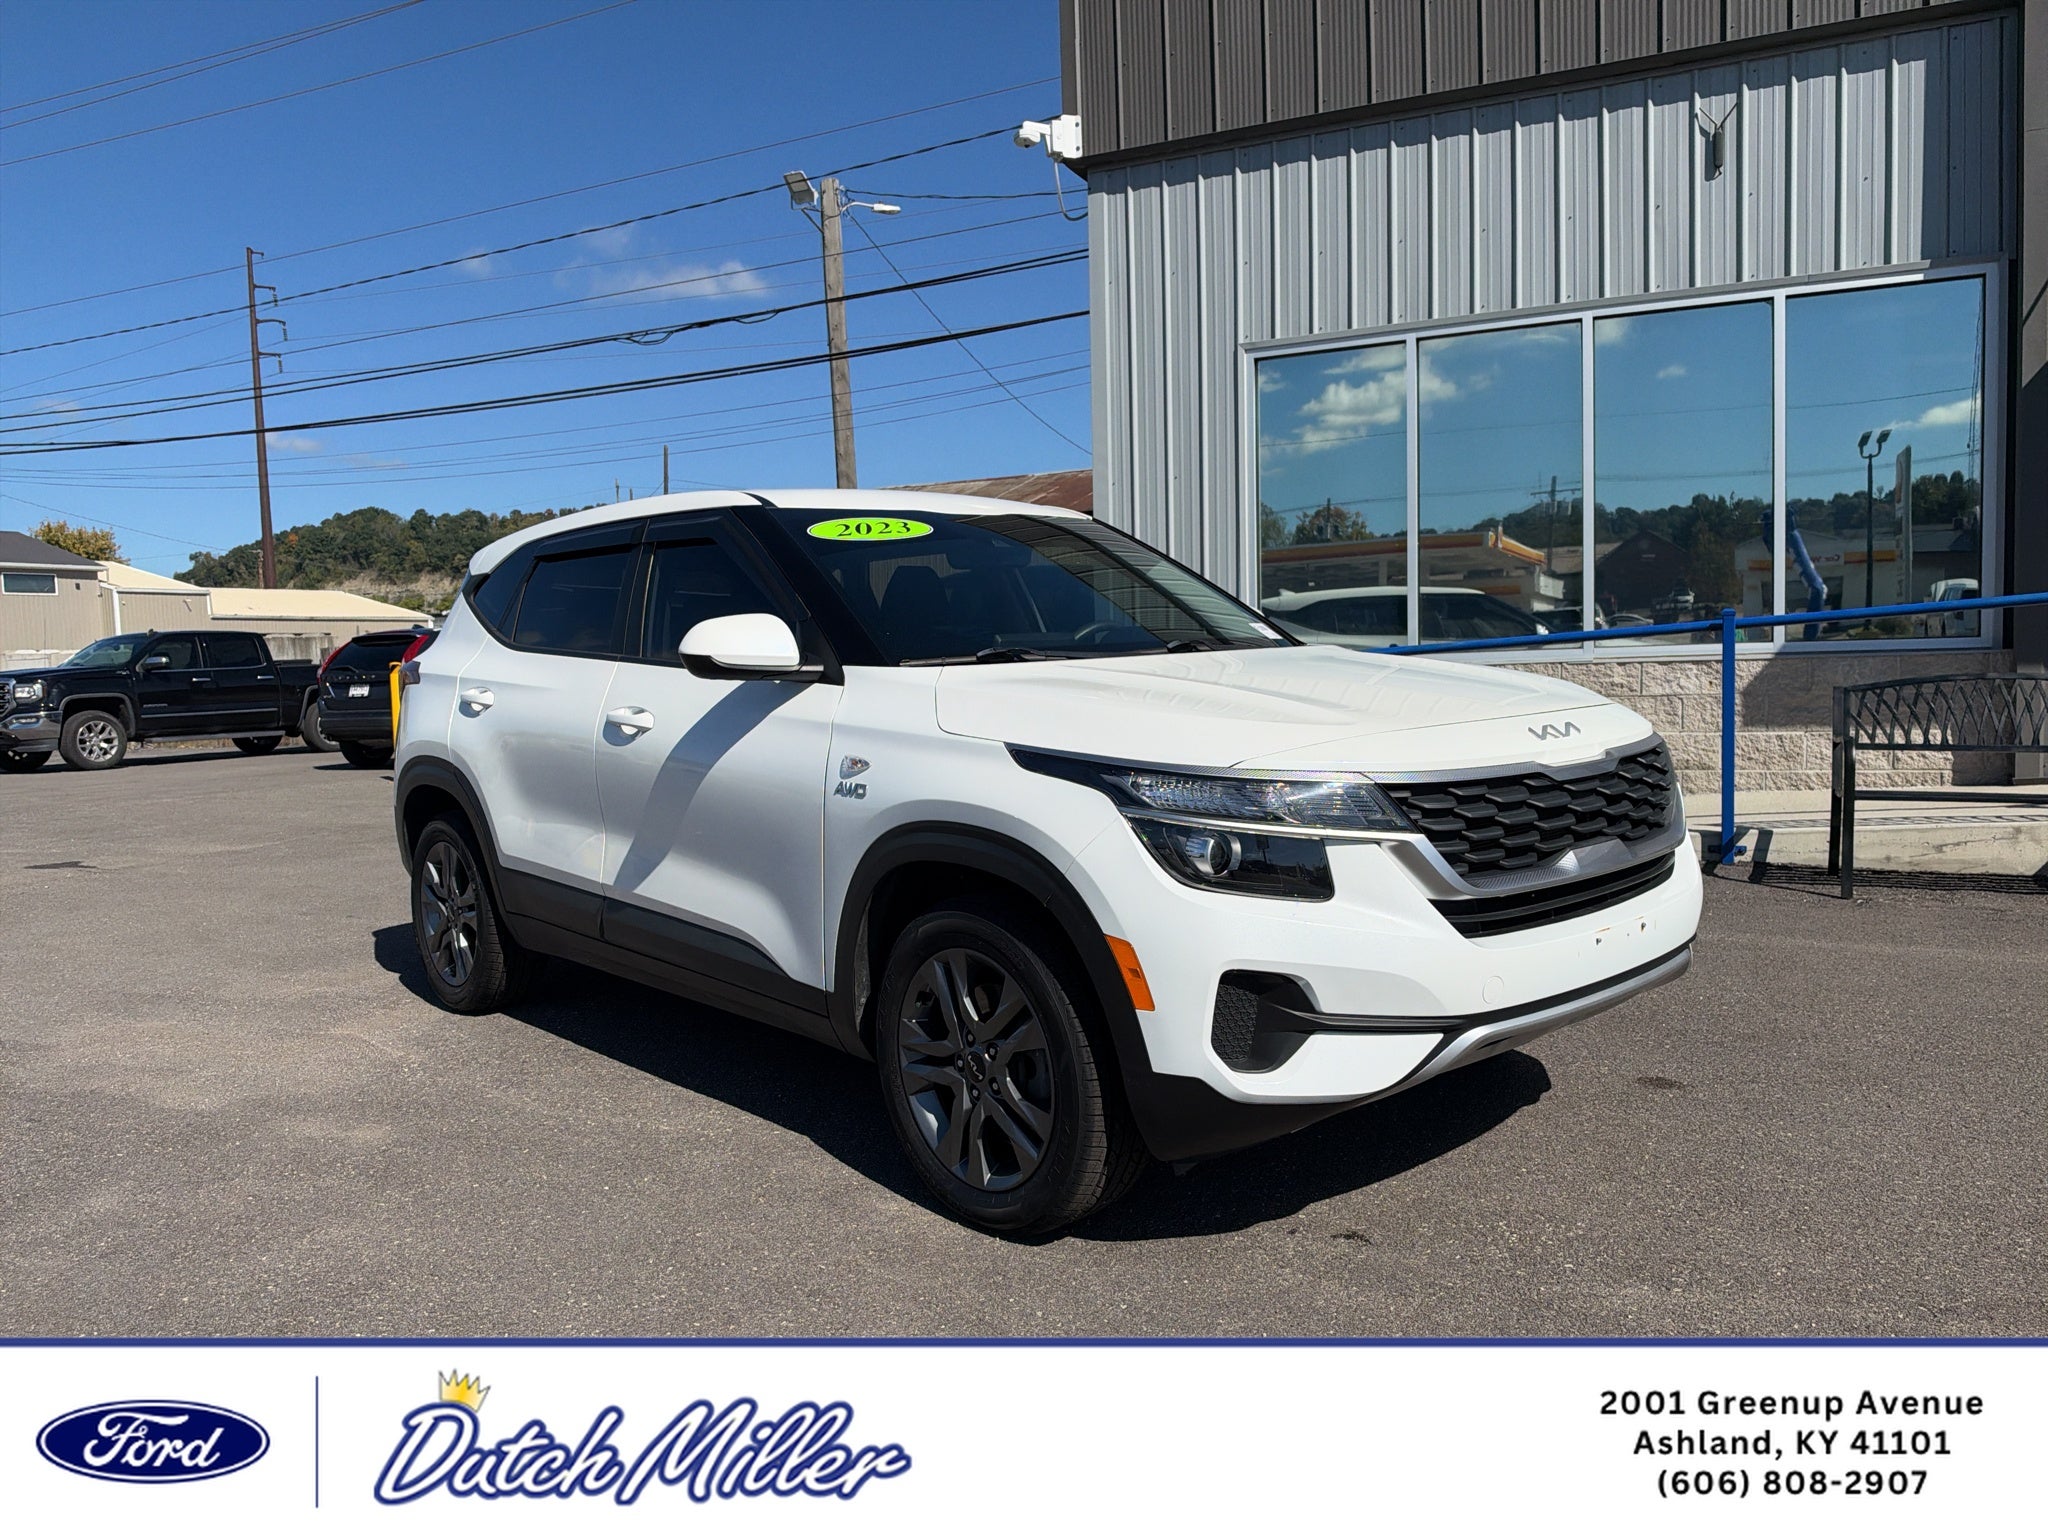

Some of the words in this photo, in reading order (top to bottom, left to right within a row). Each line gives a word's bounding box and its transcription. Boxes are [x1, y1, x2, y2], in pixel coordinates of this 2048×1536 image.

[835, 521, 911, 537] 2023
[1528, 721, 1581, 741] KIA
[833, 780, 868, 800] AWD
